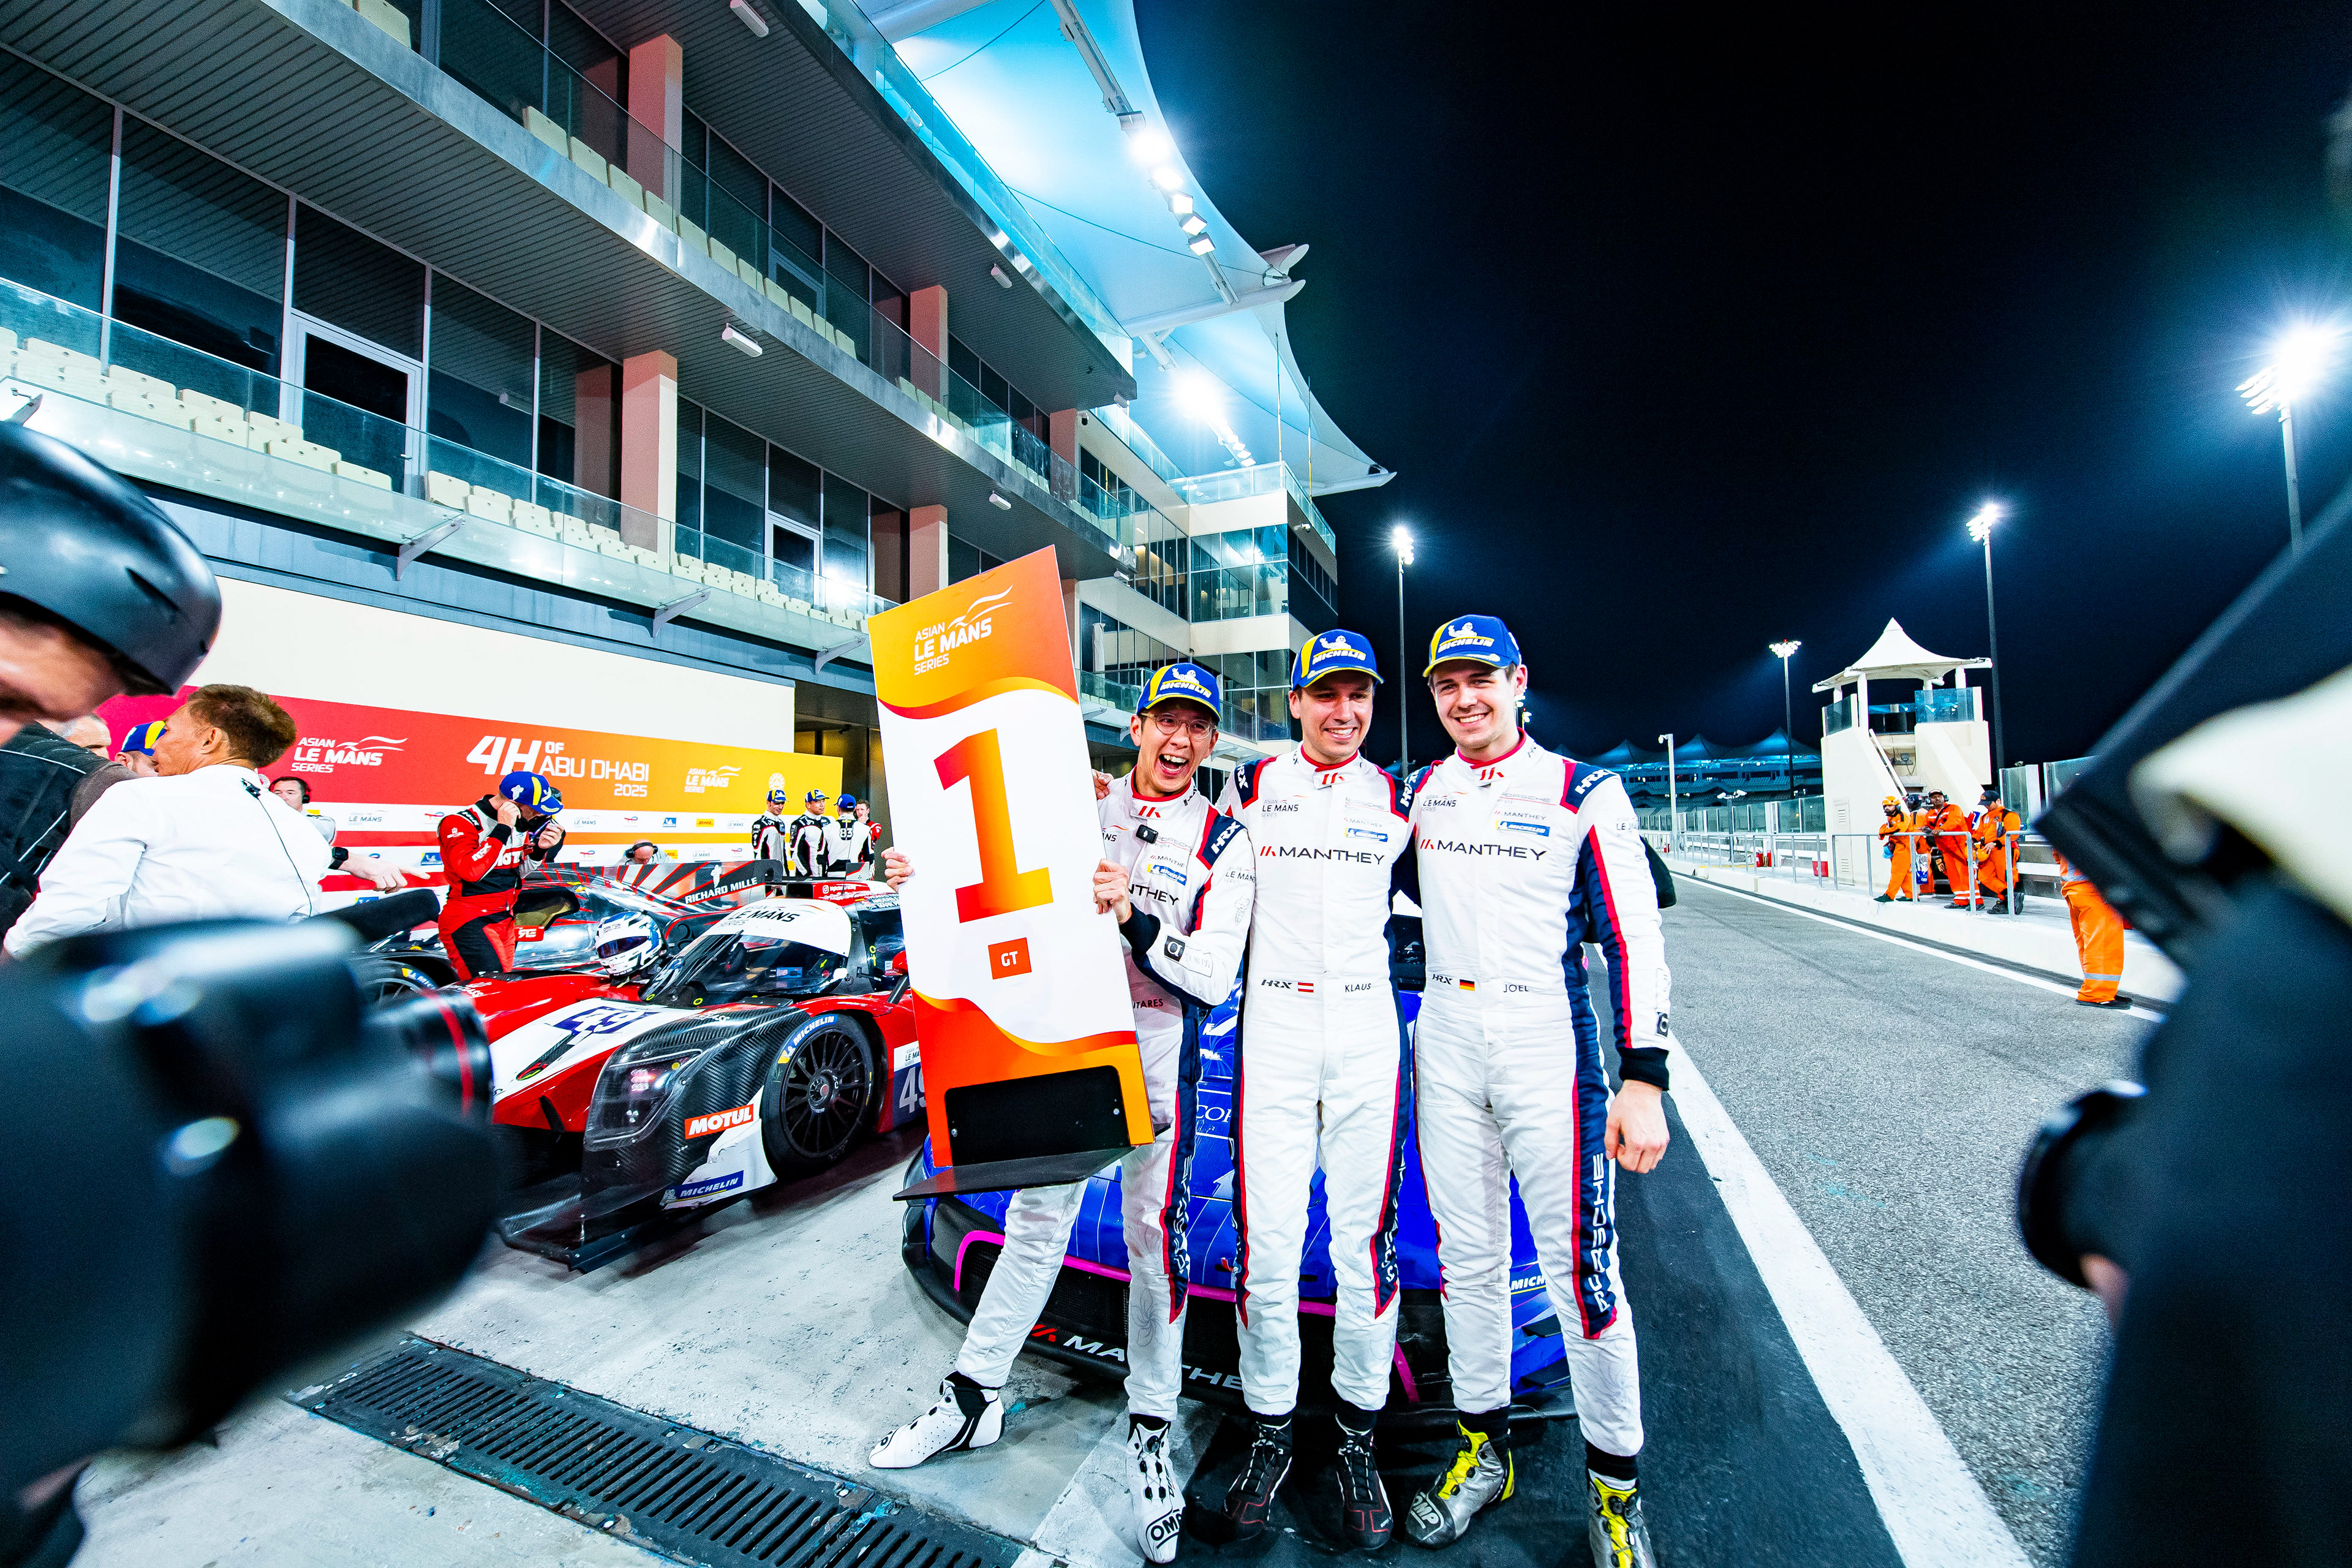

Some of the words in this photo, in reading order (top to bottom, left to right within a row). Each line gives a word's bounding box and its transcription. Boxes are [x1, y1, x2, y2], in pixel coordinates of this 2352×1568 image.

[914, 641, 935, 662] LE
[940, 617, 992, 652] MANS
[915, 622, 945, 643] ASIAN
[1437, 637, 1494, 654] MICHELIN
[914, 653, 949, 676] SERIES
[1312, 649, 1366, 665] MICHELIN
[1160, 682, 1212, 698] MICHELIN
[298, 737, 335, 748] ASIAN
[294, 747, 321, 762] LE
[324, 749, 383, 766] MANS
[466, 735, 543, 775] 4H
[545, 741, 565, 755] OF
[290, 763, 334, 773] SERIES
[539, 756, 585, 778] ABU
[590, 760, 649, 782] DHABI
[614, 783, 647, 797] 2025
[685, 775, 699, 786] LE
[700, 775, 729, 788] MANS
[1575, 769, 1610, 795] HRX
[1274, 804, 1299, 812] MANS
[1504, 812, 1547, 820] MANTHEY
[839, 827, 853, 841] 83
[933, 727, 1054, 924] 1
[1211, 821, 1241, 854] HRX
[1279, 846, 1385, 865] MANTHEY
[1436, 840, 1548, 861] MANTHEY
[1157, 855, 1185, 869] MANTHE
[685, 884, 728, 905] RICHARD
[729, 877, 758, 893] MILLE
[1128, 884, 1180, 905] NTHEY
[747, 910, 801, 922] MANS
[1000, 950, 1018, 967] GT
[1261, 979, 1293, 989] HRX
[1344, 983, 1371, 993] KLAUS
[1431, 973, 1452, 986] HRX
[1503, 984, 1529, 993] JOEL
[1133, 998, 1164, 1009] TARES
[793, 1015, 835, 1047] MICHELIN
[688, 1108, 753, 1137] MOTUL
[680, 1176, 739, 1198] MICHELIN
[1511, 1276, 1547, 1291] MICH
